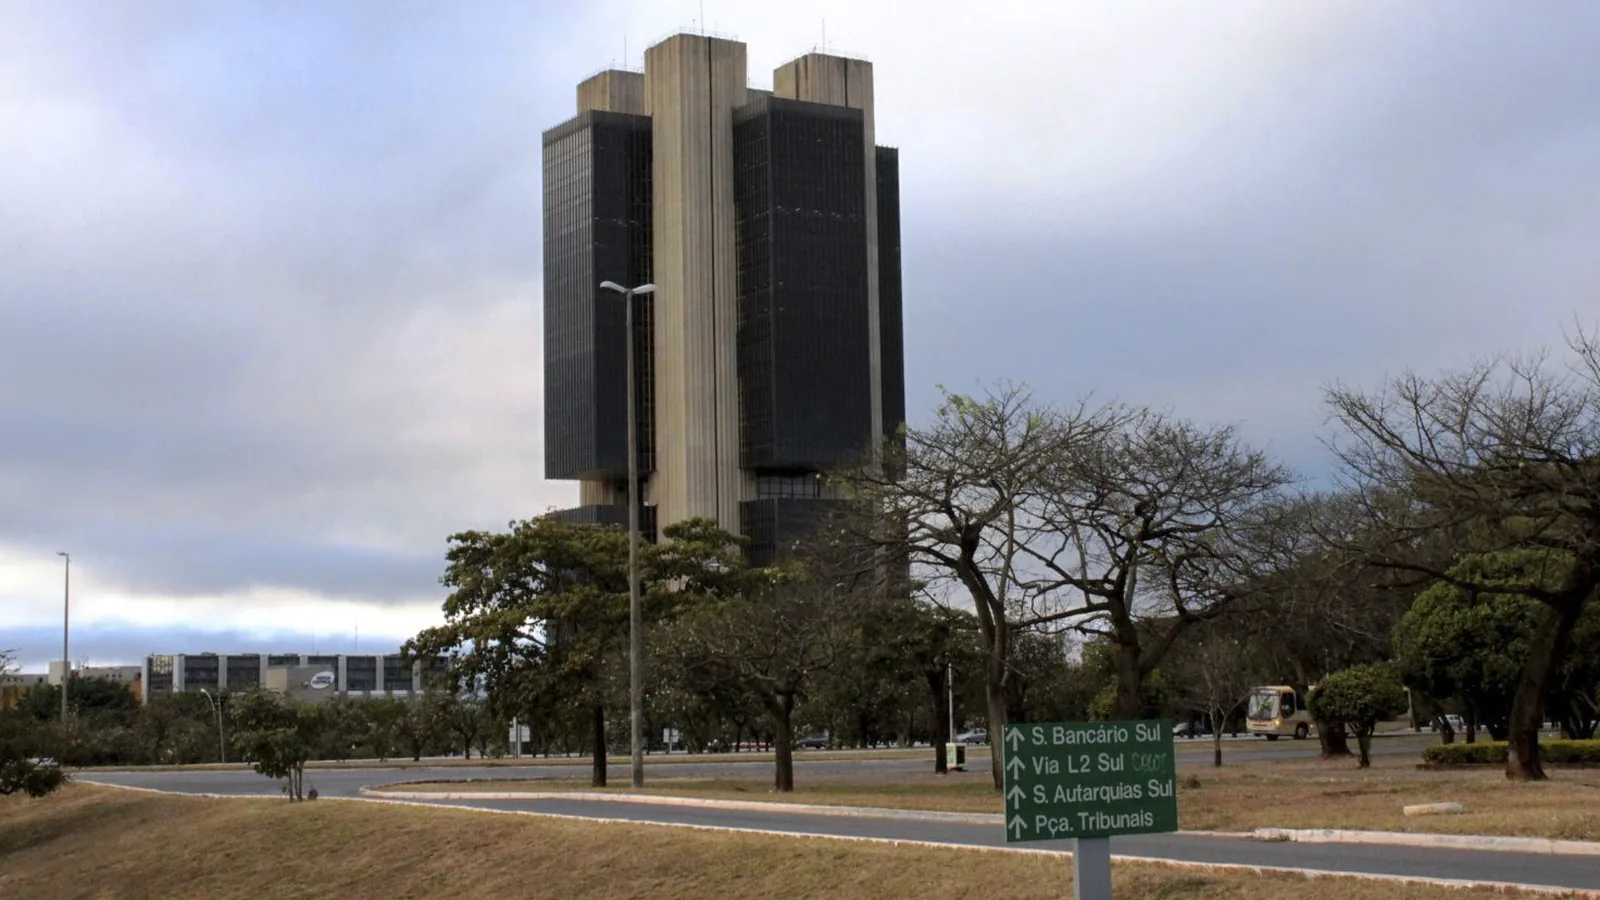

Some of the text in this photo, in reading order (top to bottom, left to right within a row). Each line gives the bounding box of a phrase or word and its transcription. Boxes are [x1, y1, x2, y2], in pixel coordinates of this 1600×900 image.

[1032, 723, 1161, 745] S. Bancário Sul
[1032, 756, 1060, 775] Via
[1068, 754, 1091, 773] L2
[1098, 753, 1124, 772] Sul
[1033, 779, 1173, 804] S. Autarquias Sul
[1035, 810, 1154, 838] Pça. Tribunais
